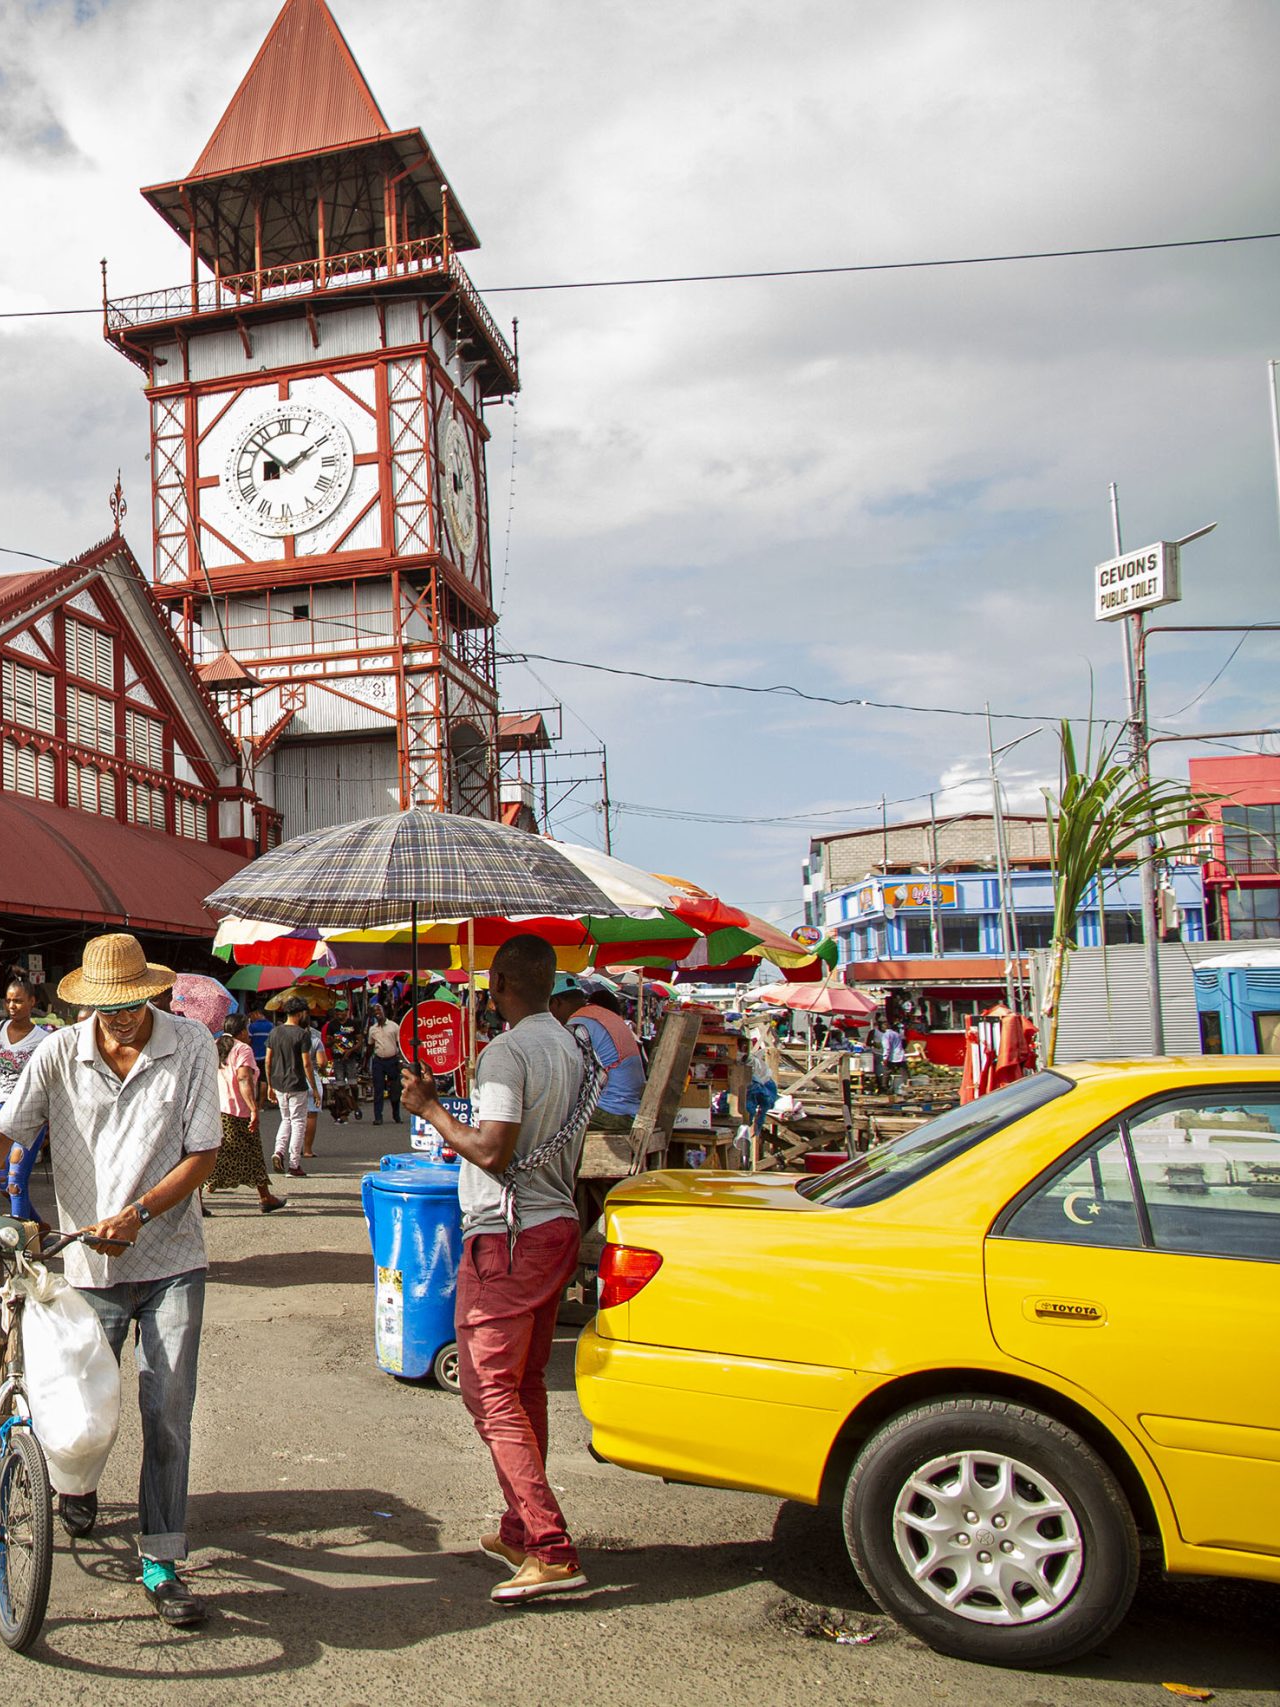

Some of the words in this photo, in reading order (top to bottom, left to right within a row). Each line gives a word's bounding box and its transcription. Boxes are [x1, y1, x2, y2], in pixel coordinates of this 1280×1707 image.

[1100, 554, 1157, 587] CEVONS
[1101, 588, 1128, 610] PUBLIC
[1131, 577, 1157, 601] TOILET
[417, 1013, 453, 1029] Digicel
[439, 1039, 450, 1047] UP
[427, 1047, 447, 1055] HERE
[453, 1101, 468, 1111] Up
[1052, 1304, 1097, 1314] TOYOTA
